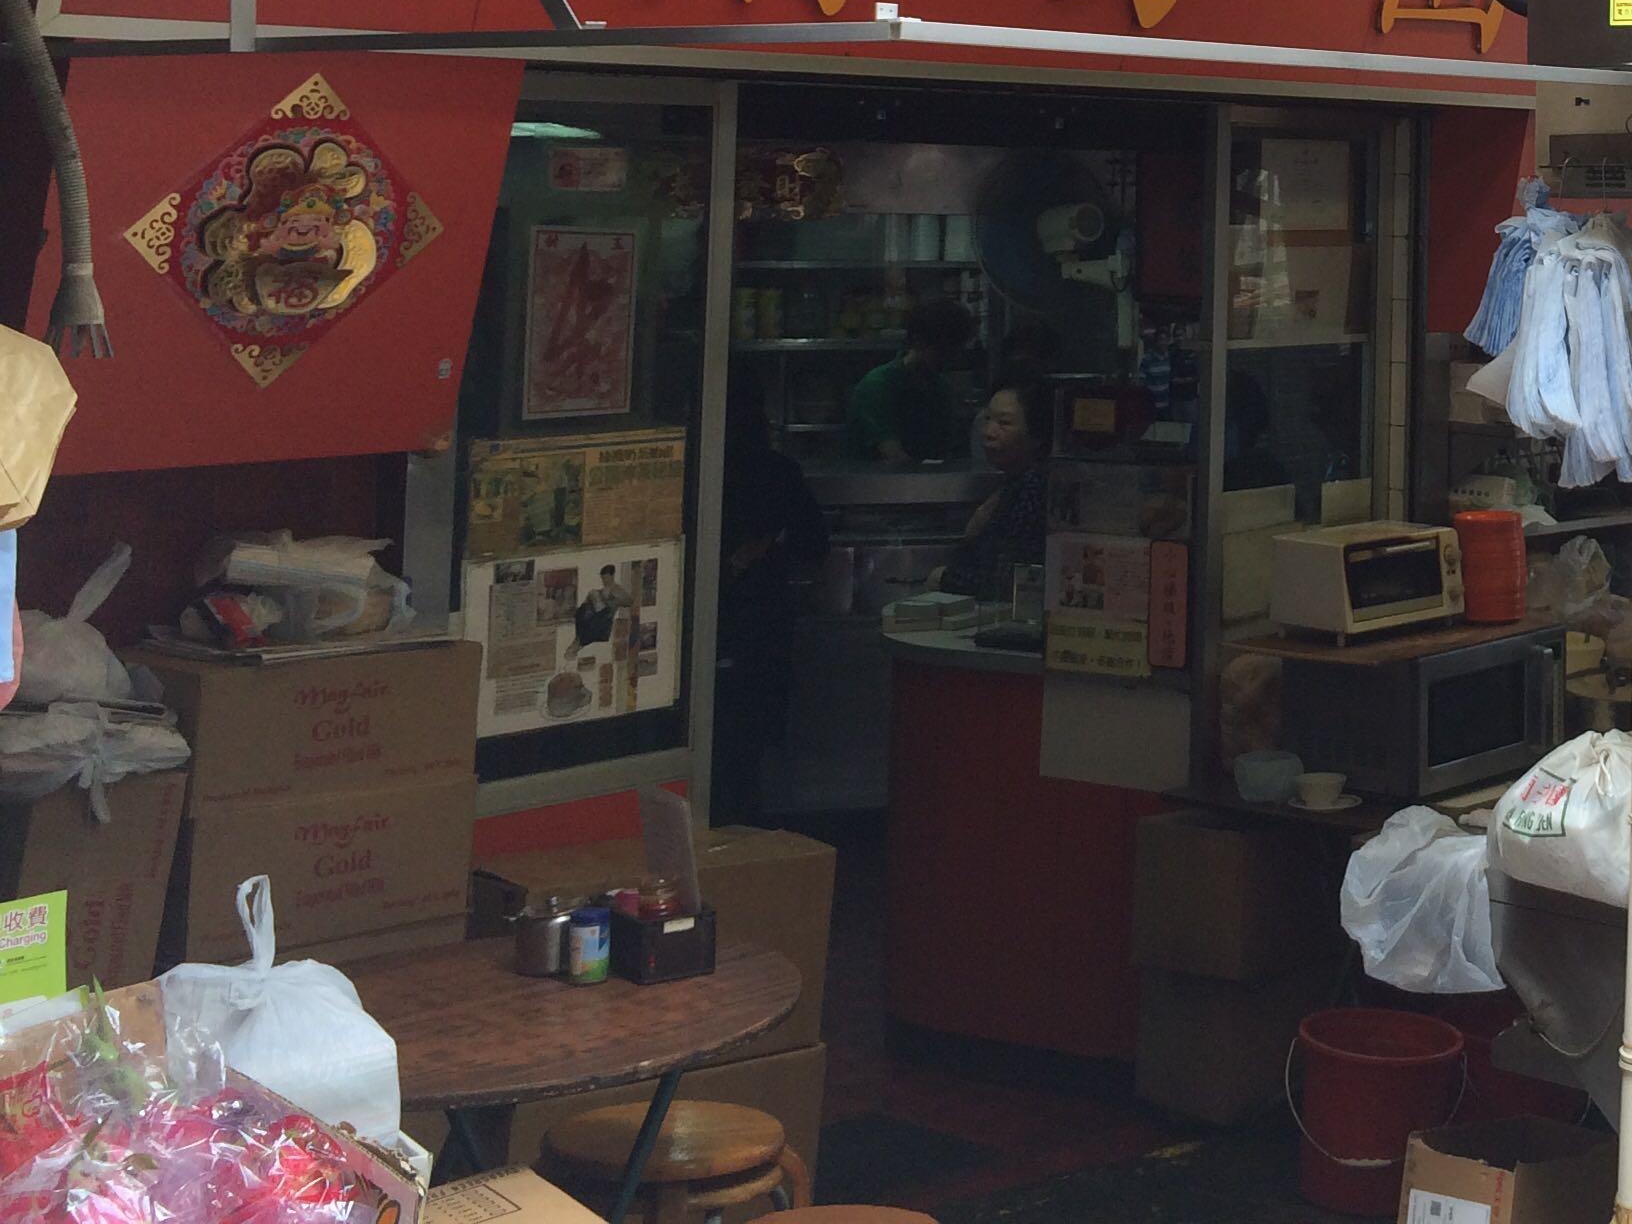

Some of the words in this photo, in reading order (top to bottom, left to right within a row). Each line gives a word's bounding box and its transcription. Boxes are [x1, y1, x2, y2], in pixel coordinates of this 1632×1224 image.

[314, 850, 372, 877] Gold
[4, 906, 46, 932] 收費
[0, 931, 47, 949] Charging
